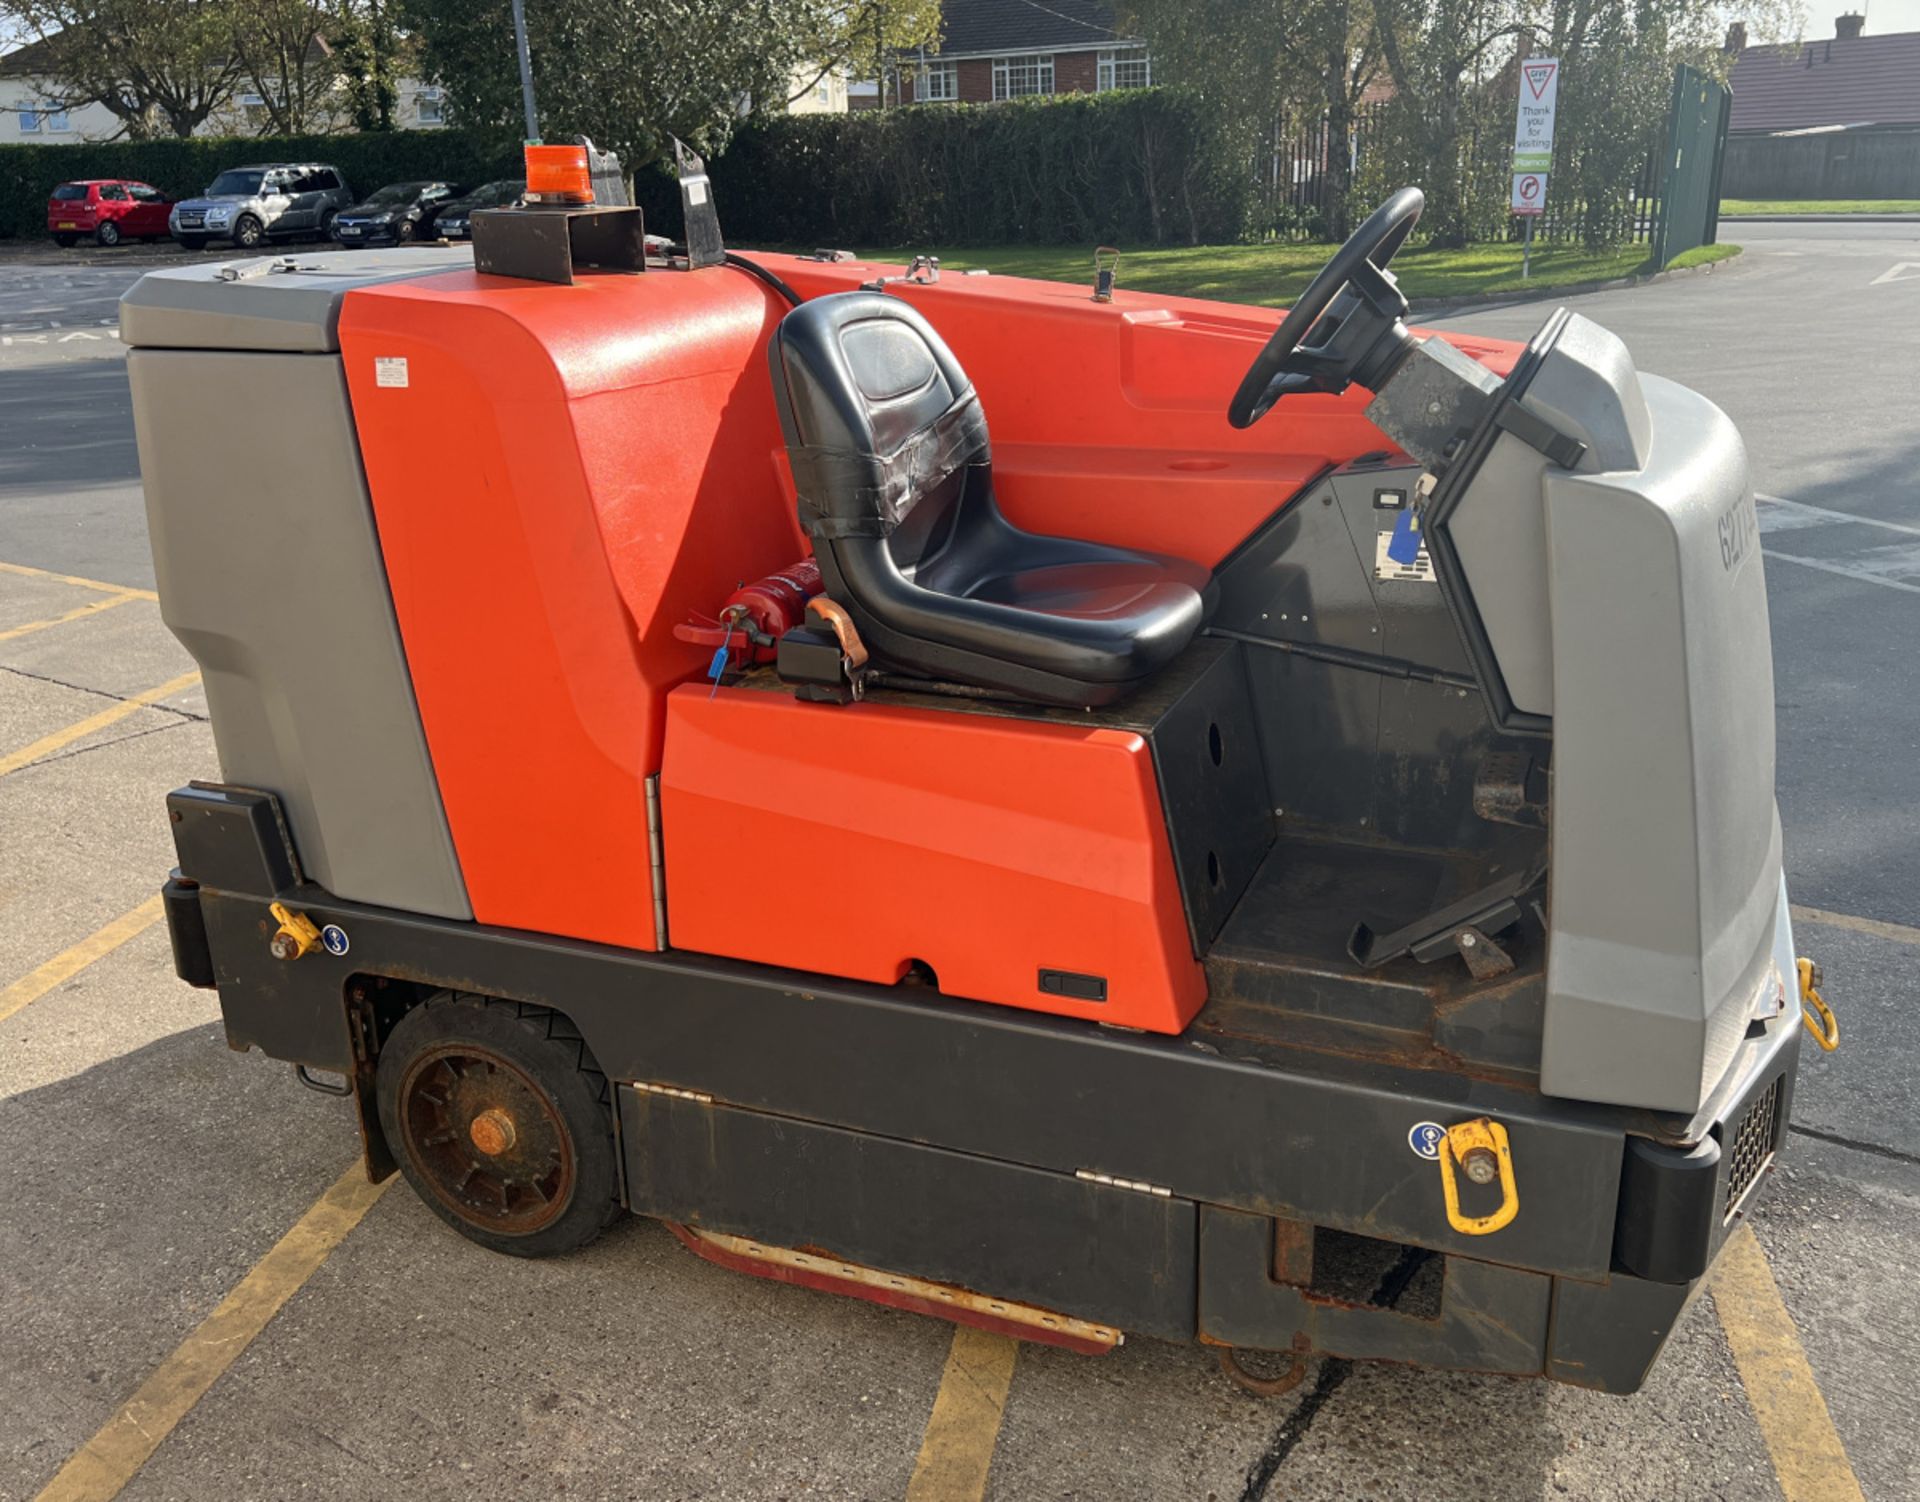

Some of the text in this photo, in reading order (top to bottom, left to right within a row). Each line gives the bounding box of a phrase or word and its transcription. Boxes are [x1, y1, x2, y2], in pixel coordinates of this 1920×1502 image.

[1522, 105, 1551, 116] Thank
[1527, 118, 1544, 128] you
[1527, 127, 1542, 136] for
[1517, 139, 1551, 149] visiting
